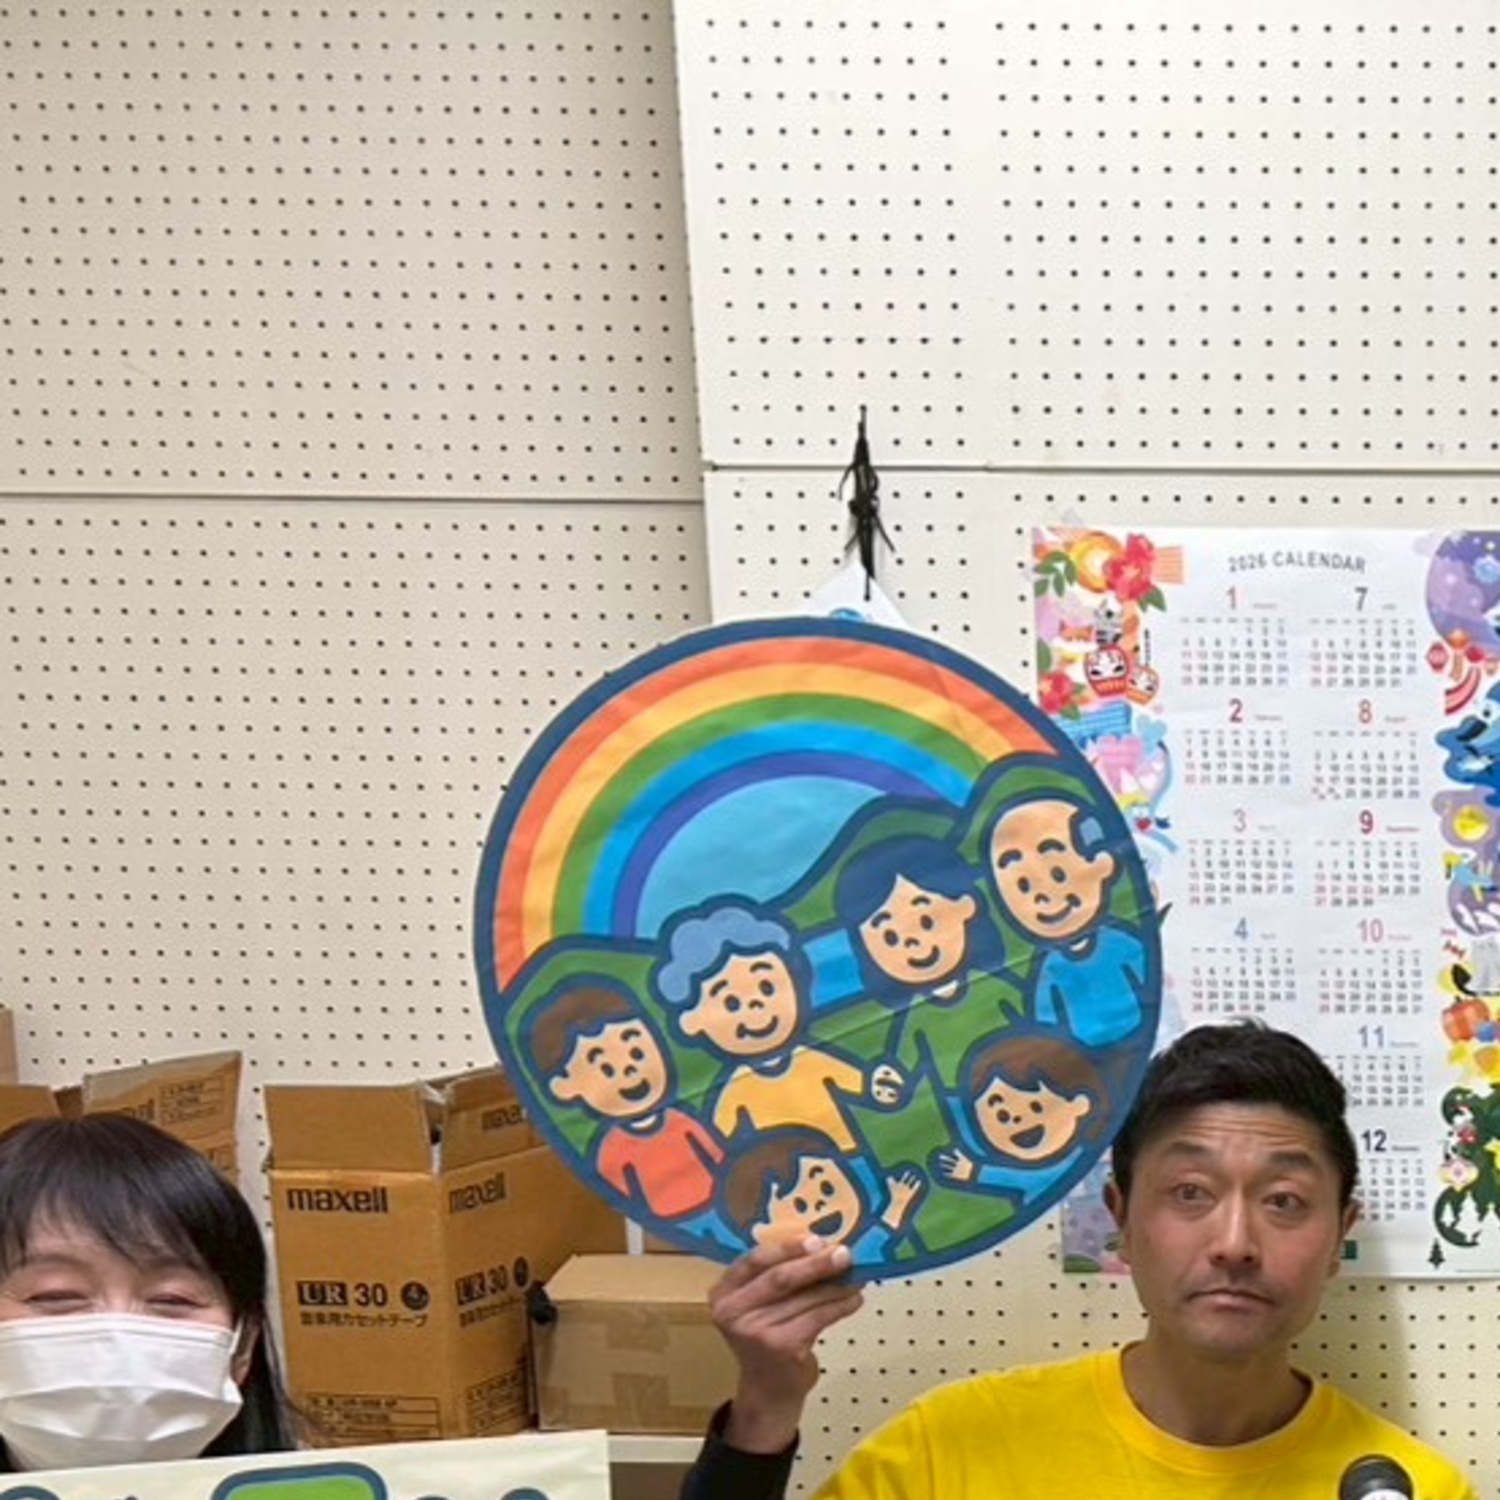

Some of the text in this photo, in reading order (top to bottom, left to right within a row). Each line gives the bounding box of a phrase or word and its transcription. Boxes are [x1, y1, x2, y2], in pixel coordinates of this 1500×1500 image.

[1228, 550, 1366, 575] 2026 CALENDAR
[1226, 586, 1236, 610] 1
[1355, 586, 1368, 611] 7
[1229, 698, 1243, 723] 2
[1358, 699, 1372, 724] 8
[1233, 808, 1247, 833] 3
[1359, 809, 1374, 835] 9
[1234, 916, 1248, 940] 4
[1357, 918, 1384, 943] 10
[1359, 1025, 1384, 1048] 11
[1361, 1129, 1387, 1152] 12
[287, 1187, 388, 1213] maxell
[449, 1172, 506, 1214] maxell
[488, 1265, 508, 1294] 30
[299, 1281, 389, 1307] UR 30
